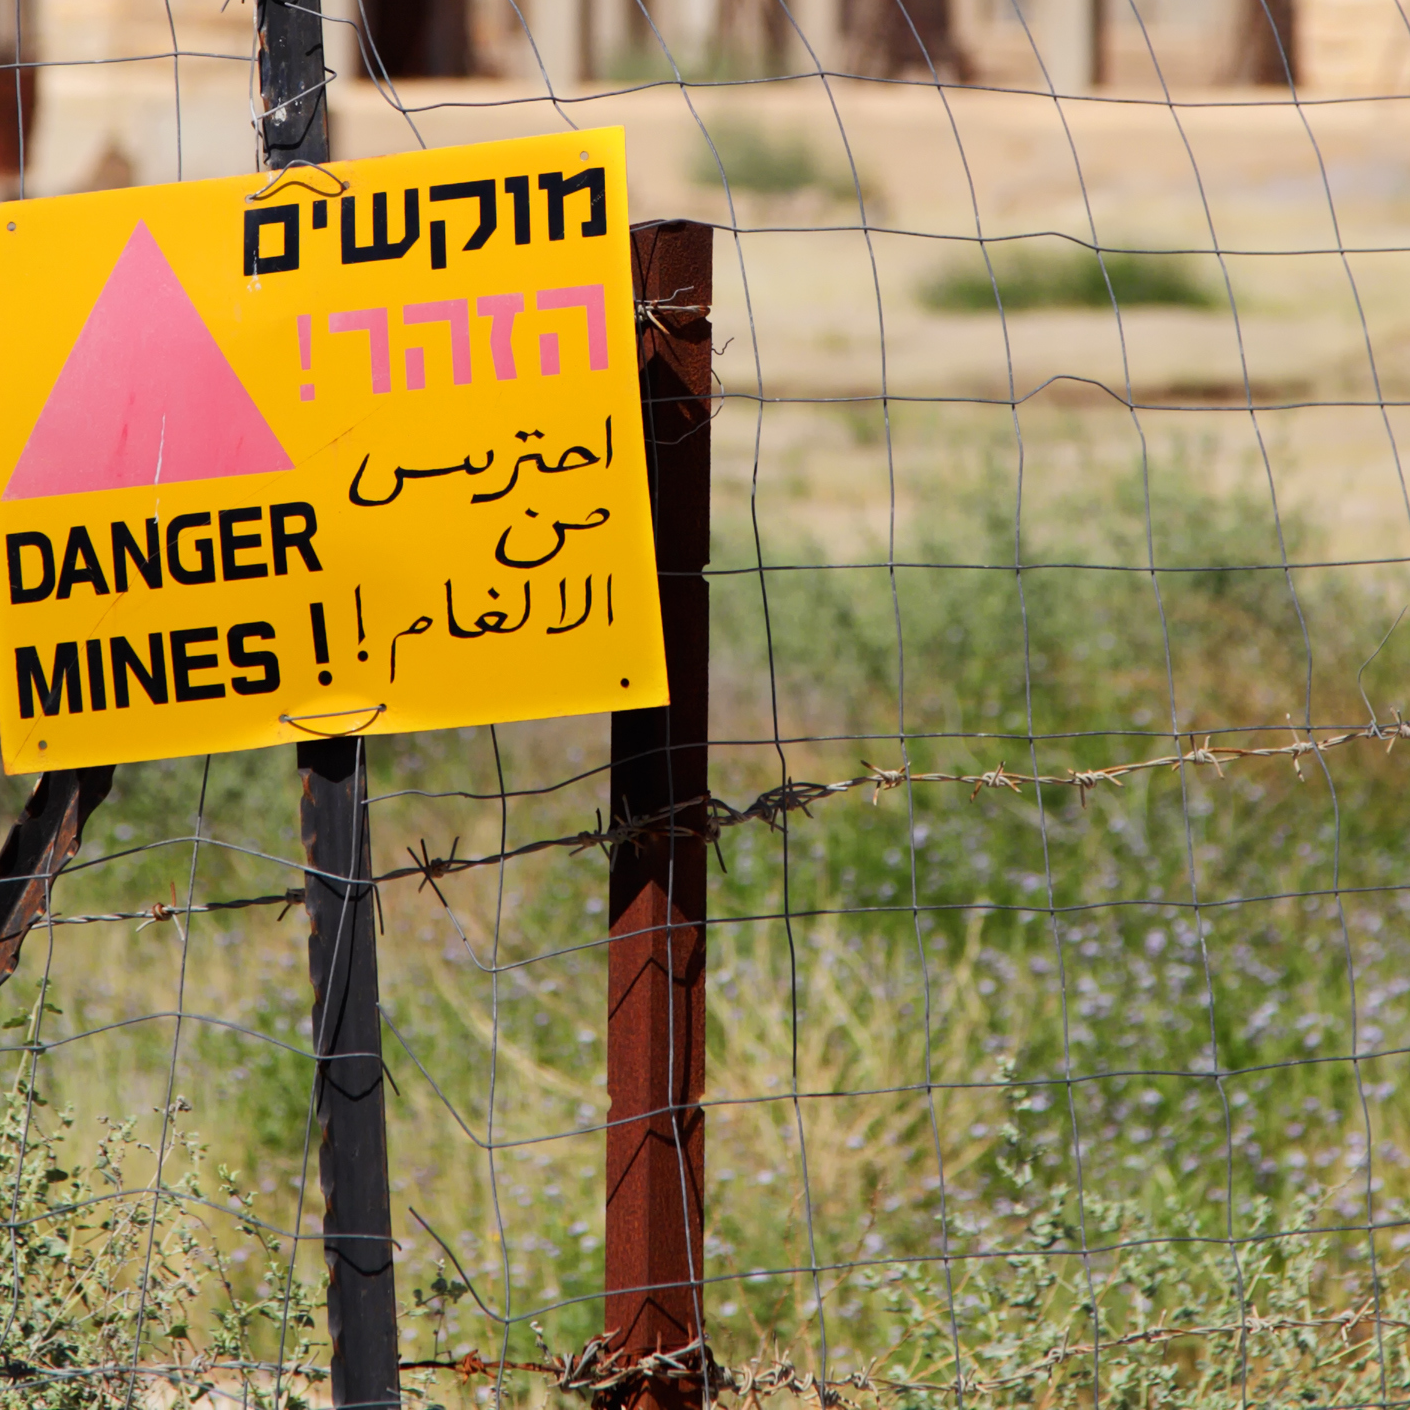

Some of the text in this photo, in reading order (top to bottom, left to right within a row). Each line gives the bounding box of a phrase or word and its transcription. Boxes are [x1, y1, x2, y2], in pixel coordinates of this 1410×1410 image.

[243, 167, 607, 277] מוקשים
[296, 283, 609, 402] הזהר!
[6, 501, 323, 605] DANGER
[495, 507, 610, 569] من
